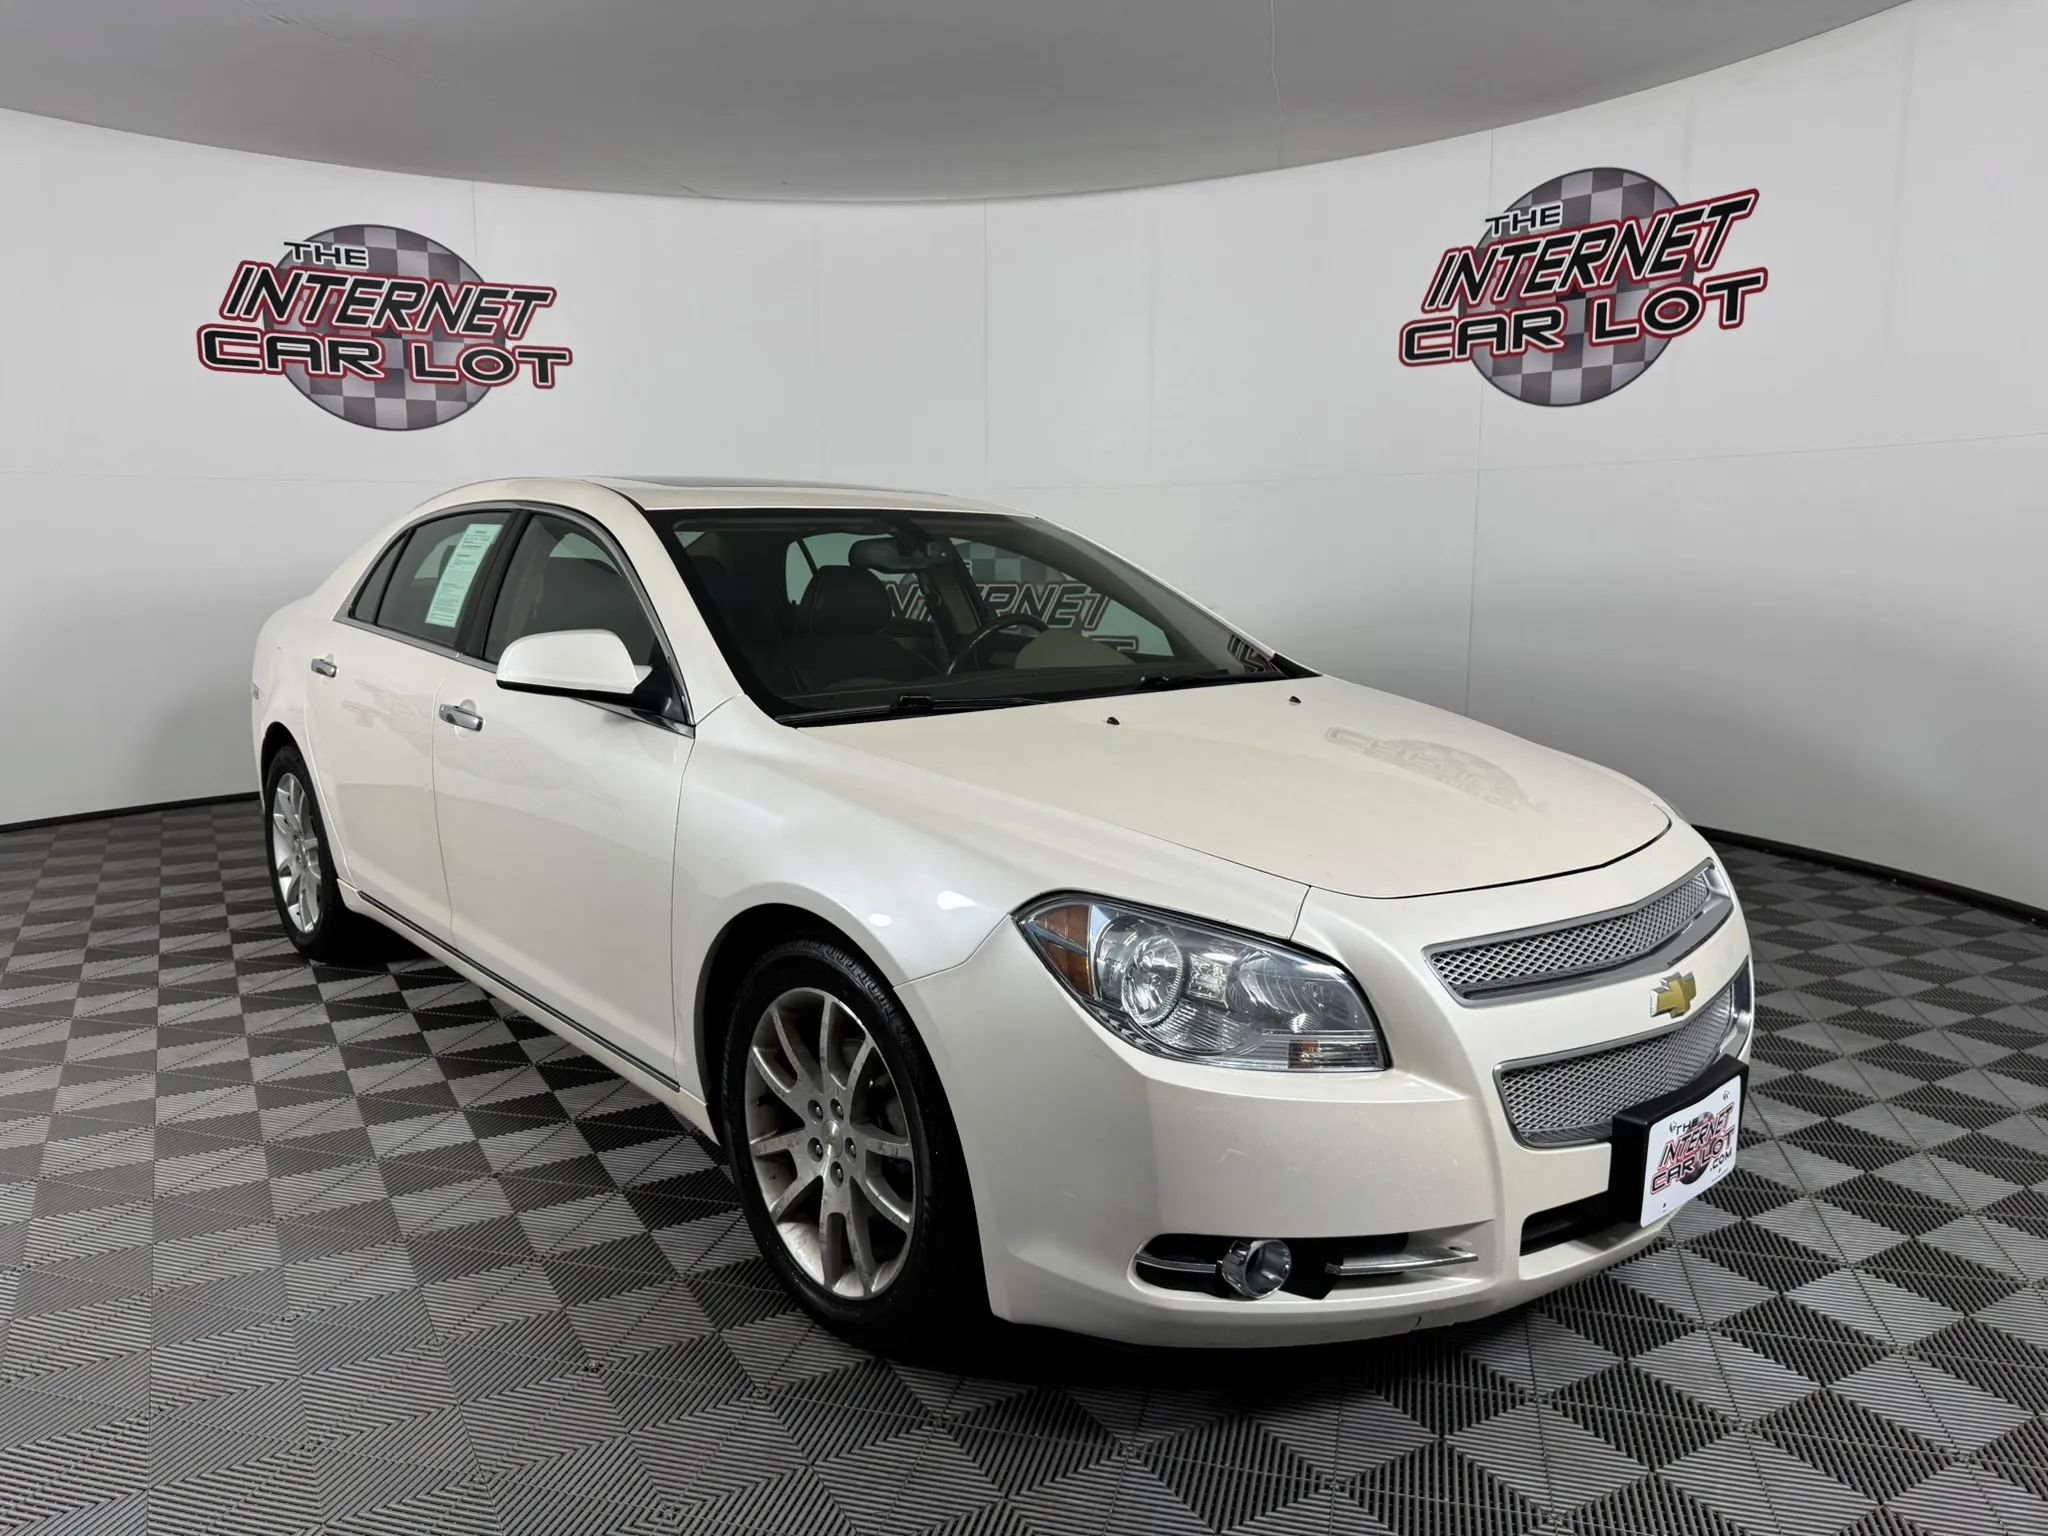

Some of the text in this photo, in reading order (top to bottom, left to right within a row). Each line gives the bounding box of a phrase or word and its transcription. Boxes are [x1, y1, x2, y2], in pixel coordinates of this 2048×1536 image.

[1423, 190, 1758, 312] INTERNET
[1485, 201, 1563, 236] THE
[284, 241, 368, 268] THE
[220, 261, 556, 339] INTERNET
[1401, 269, 1766, 366] CAR LOT
[198, 324, 572, 388] CAR LOT
[1651, 1125, 1735, 1194] CAR LOT
[1658, 1102, 1734, 1170] INTERNET
[1674, 1117, 1699, 1135] THE
